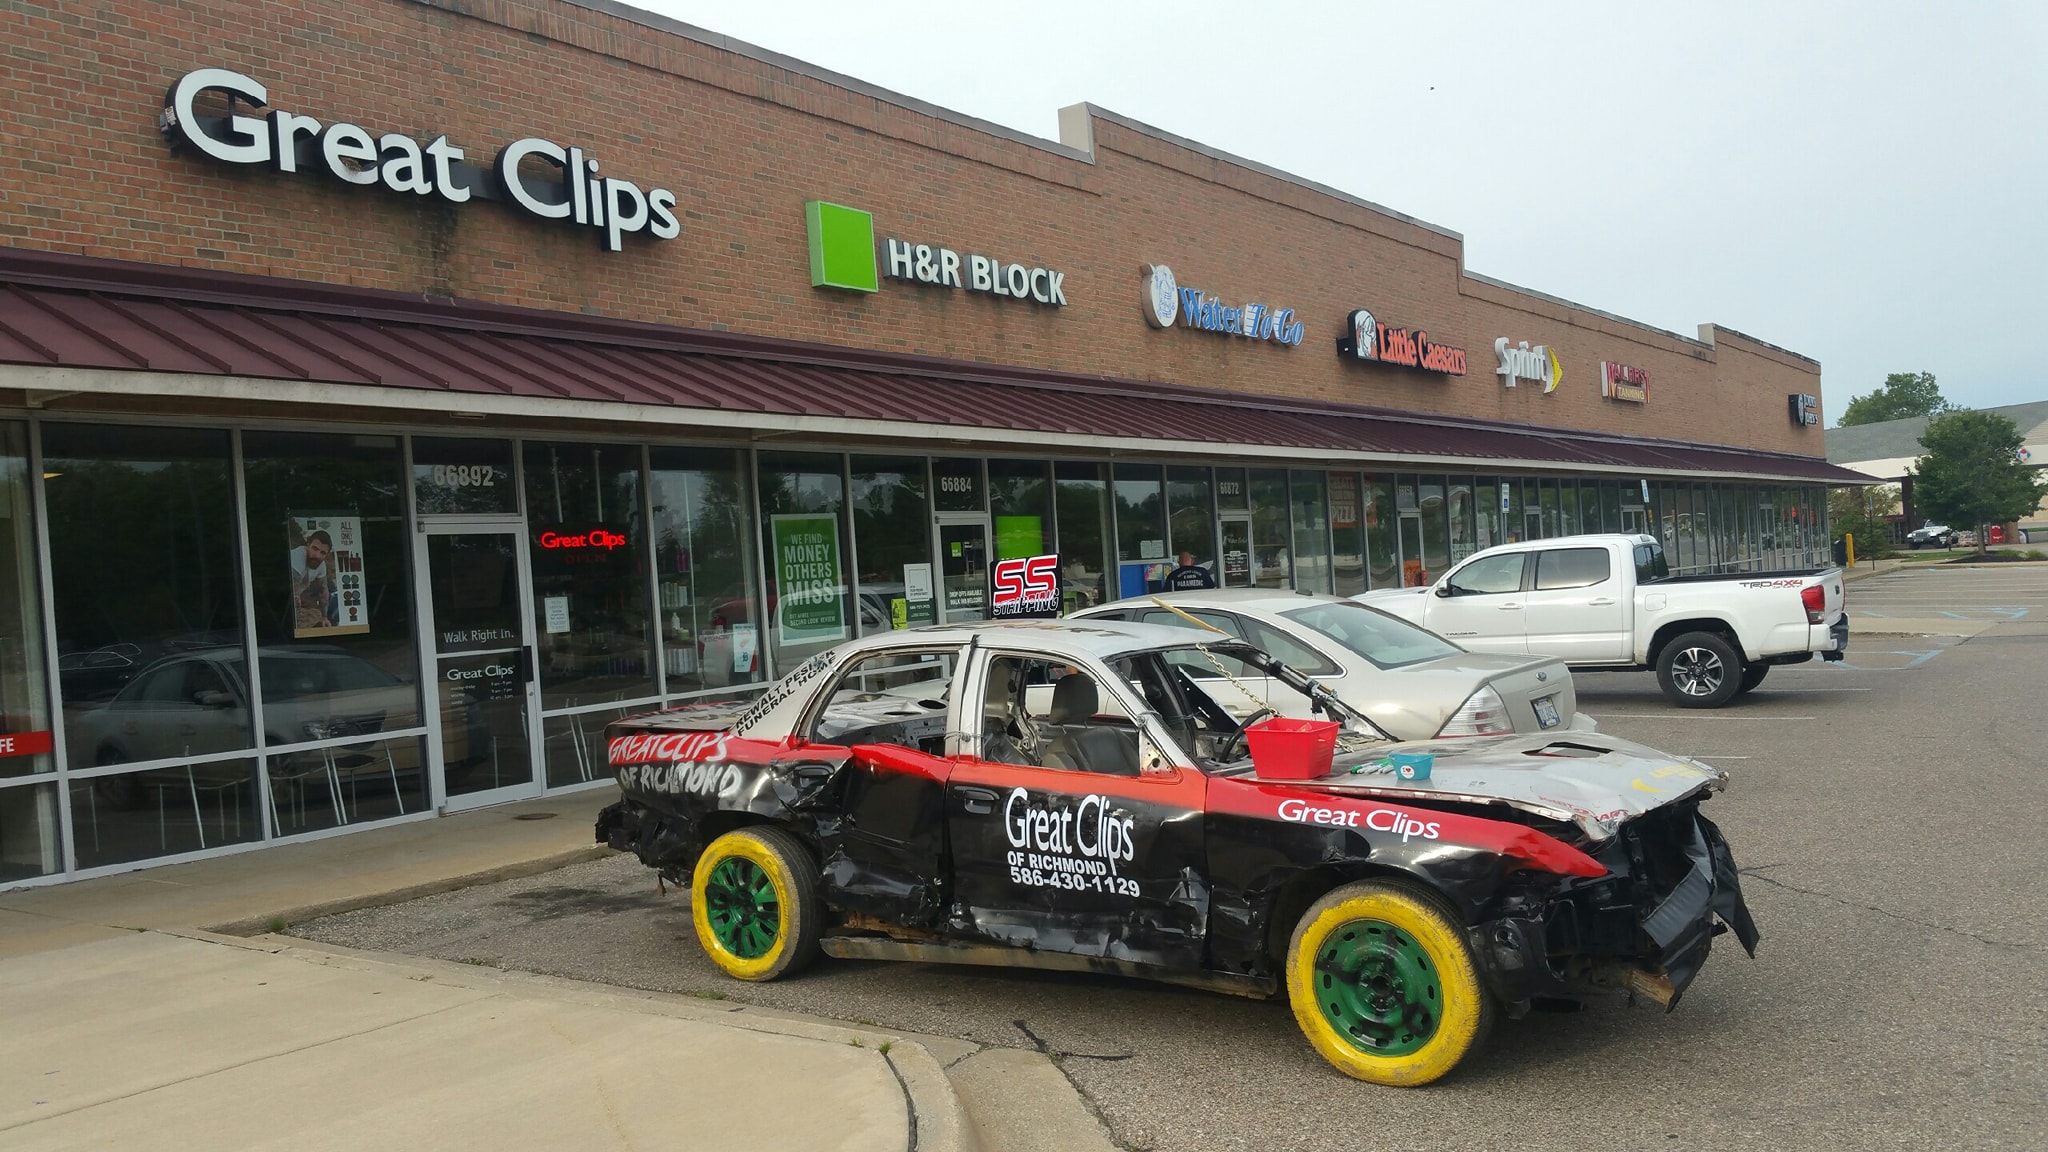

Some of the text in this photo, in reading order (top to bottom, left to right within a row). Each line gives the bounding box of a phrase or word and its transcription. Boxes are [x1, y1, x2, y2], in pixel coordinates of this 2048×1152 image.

[174, 68, 681, 252] Great Clips
[886, 237, 1068, 306] H&R BLOCK
[1176, 286, 1305, 347] Water To Go
[1375, 322, 1468, 376] Little Caesars
[1494, 336, 1548, 388] Sprint
[1617, 386, 1646, 401] TANNING
[432, 464, 495, 487] 66892
[940, 476, 973, 493] 66884
[1219, 481, 1240, 495] 66872
[340, 521, 353, 530] ALL
[540, 530, 626, 551] Great Clips
[790, 532, 823, 545] WE FIND
[783, 543, 831, 564] MONEY
[784, 562, 833, 581] OTHERS
[993, 554, 1058, 605] SS
[1176, 579, 1204, 588] PARAMEDIC
[786, 578, 835, 607] MISS
[1738, 580, 1773, 589] TRD
[993, 587, 1060, 616] STRIPPING
[790, 618, 807, 627] SECOND
[443, 628, 515, 645] Walk Right In.
[446, 664, 514, 681] Great Clips
[737, 687, 797, 737] FUNERAL
[798, 654, 837, 688] HOME
[619, 760, 744, 799] OF RICHMOND
[1005, 786, 1135, 877] Great Clips
[1277, 799, 1441, 843] Great Clips
[1007, 850, 1108, 877] OF RICHMOND
[1009, 866, 1142, 898] 586-430-1129
